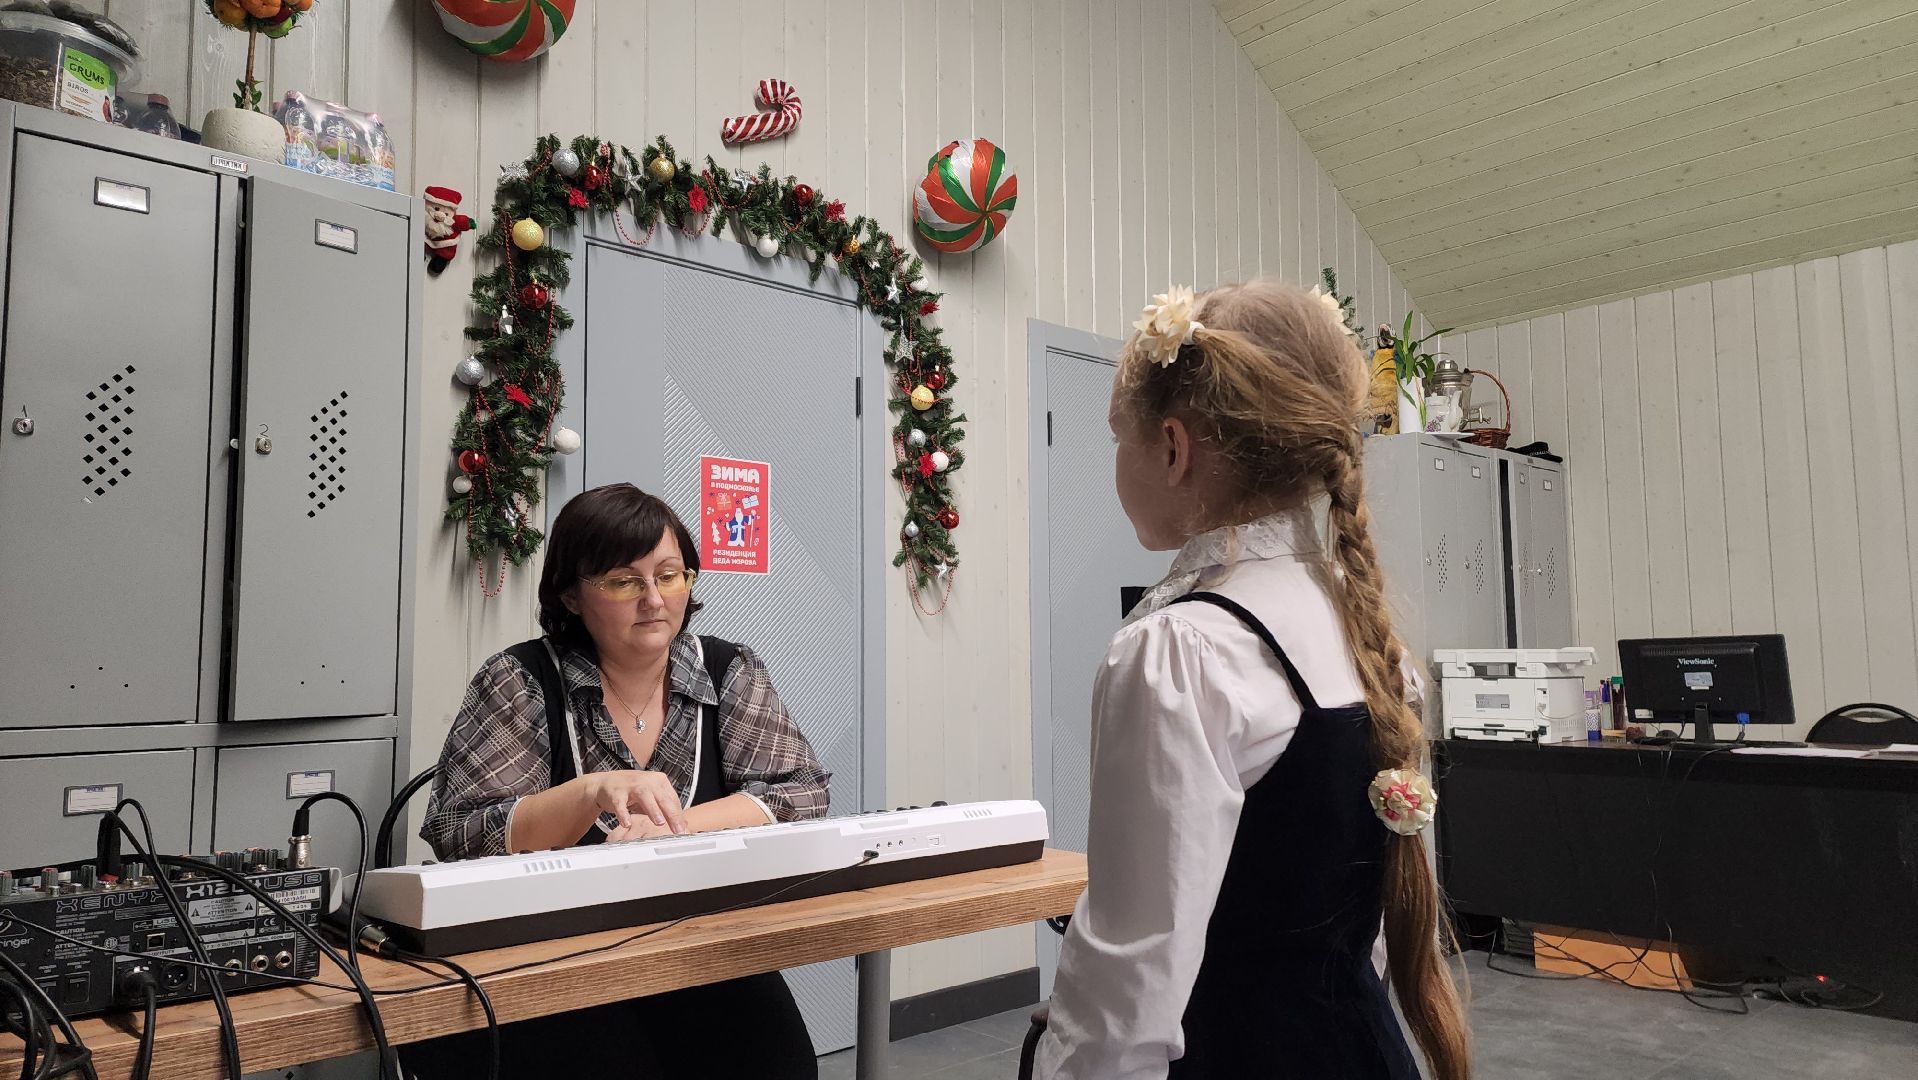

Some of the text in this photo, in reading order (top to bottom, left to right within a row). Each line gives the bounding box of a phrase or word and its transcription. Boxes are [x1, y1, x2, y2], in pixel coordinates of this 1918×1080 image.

[69, 63, 105, 85] GRUMS
[259, 423, 269, 437] 2
[710, 464, 760, 484] ЗИМА
[712, 549, 757, 559] РЕЗИДЕНЦИЯ
[712, 557, 757, 566] ДЕДА МОРОЗА
[1677, 657, 1715, 665] ViewSonic
